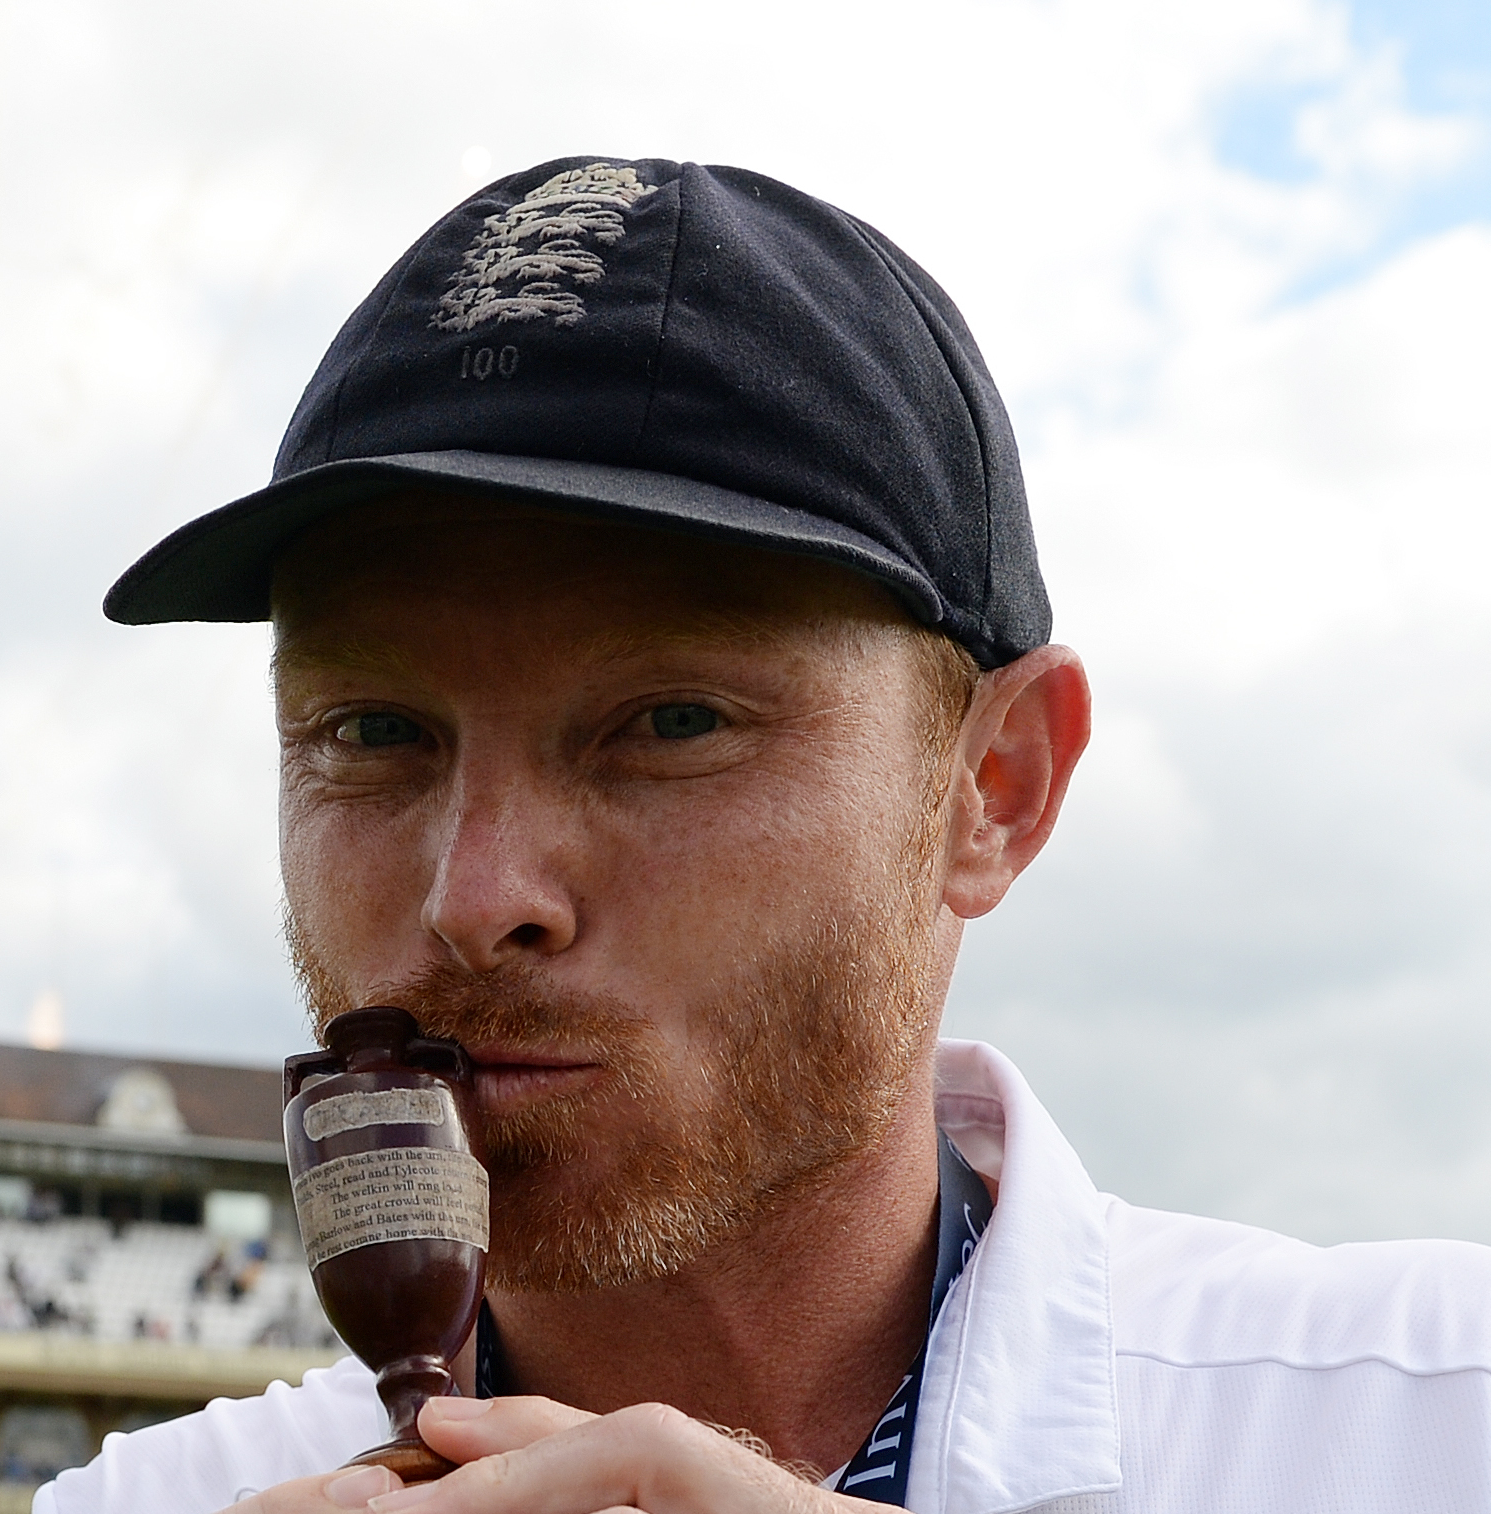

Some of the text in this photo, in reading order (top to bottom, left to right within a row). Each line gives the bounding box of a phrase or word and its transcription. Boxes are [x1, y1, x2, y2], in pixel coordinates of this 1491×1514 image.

[460, 344, 520, 381] 100
[323, 1160, 345, 1178] goes
[347, 1153, 374, 1168] back
[377, 1150, 403, 1162] with
[405, 1149, 423, 1161] the
[342, 1169, 366, 1186] read
[368, 1166, 390, 1179] and
[391, 1163, 440, 1178] Tylecote
[330, 1191, 350, 1205] The
[351, 1183, 390, 1198] welkin
[392, 1179, 415, 1191] will
[332, 1207, 351, 1220] The
[353, 1199, 382, 1217] great
[384, 1194, 420, 1208] crowd
[422, 1195, 444, 1207] will
[318, 1222, 352, 1243] Barlow
[353, 1214, 374, 1230] and
[376, 1212, 410, 1225] Bates
[410, 1209, 437, 1222] with
[384, 1228, 418, 1239] home
[419, 1226, 445, 1237] with
